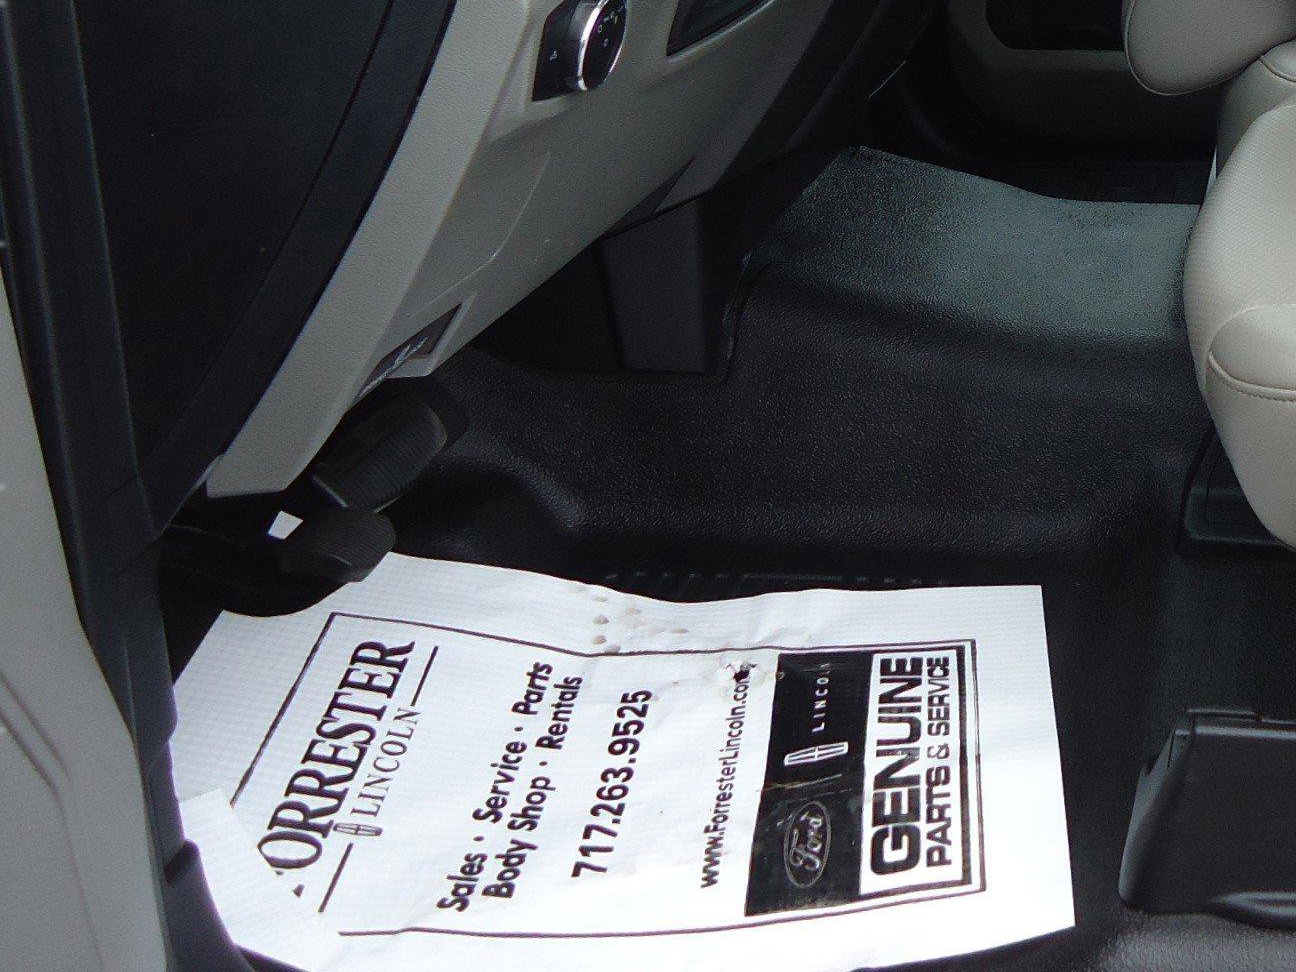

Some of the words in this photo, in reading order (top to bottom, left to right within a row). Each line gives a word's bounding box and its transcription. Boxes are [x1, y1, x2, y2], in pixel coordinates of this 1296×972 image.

[535, 676, 584, 750] Rentals
[926, 656, 951, 736] SERVICE
[257, 640, 415, 898] ORRESTER
[350, 707, 421, 817] LINCOLN
[436, 852, 488, 912] Sales
[472, 740, 528, 824] Service
[511, 661, 553, 716] Parts
[571, 690, 652, 878] 717.263.9525
[870, 656, 924, 876] GENUINE
[927, 742, 950, 760] &
[507, 776, 556, 831] Shop
[789, 809, 823, 871] Ford
[925, 765, 952, 868] PARTS
[481, 839, 538, 898] Body
